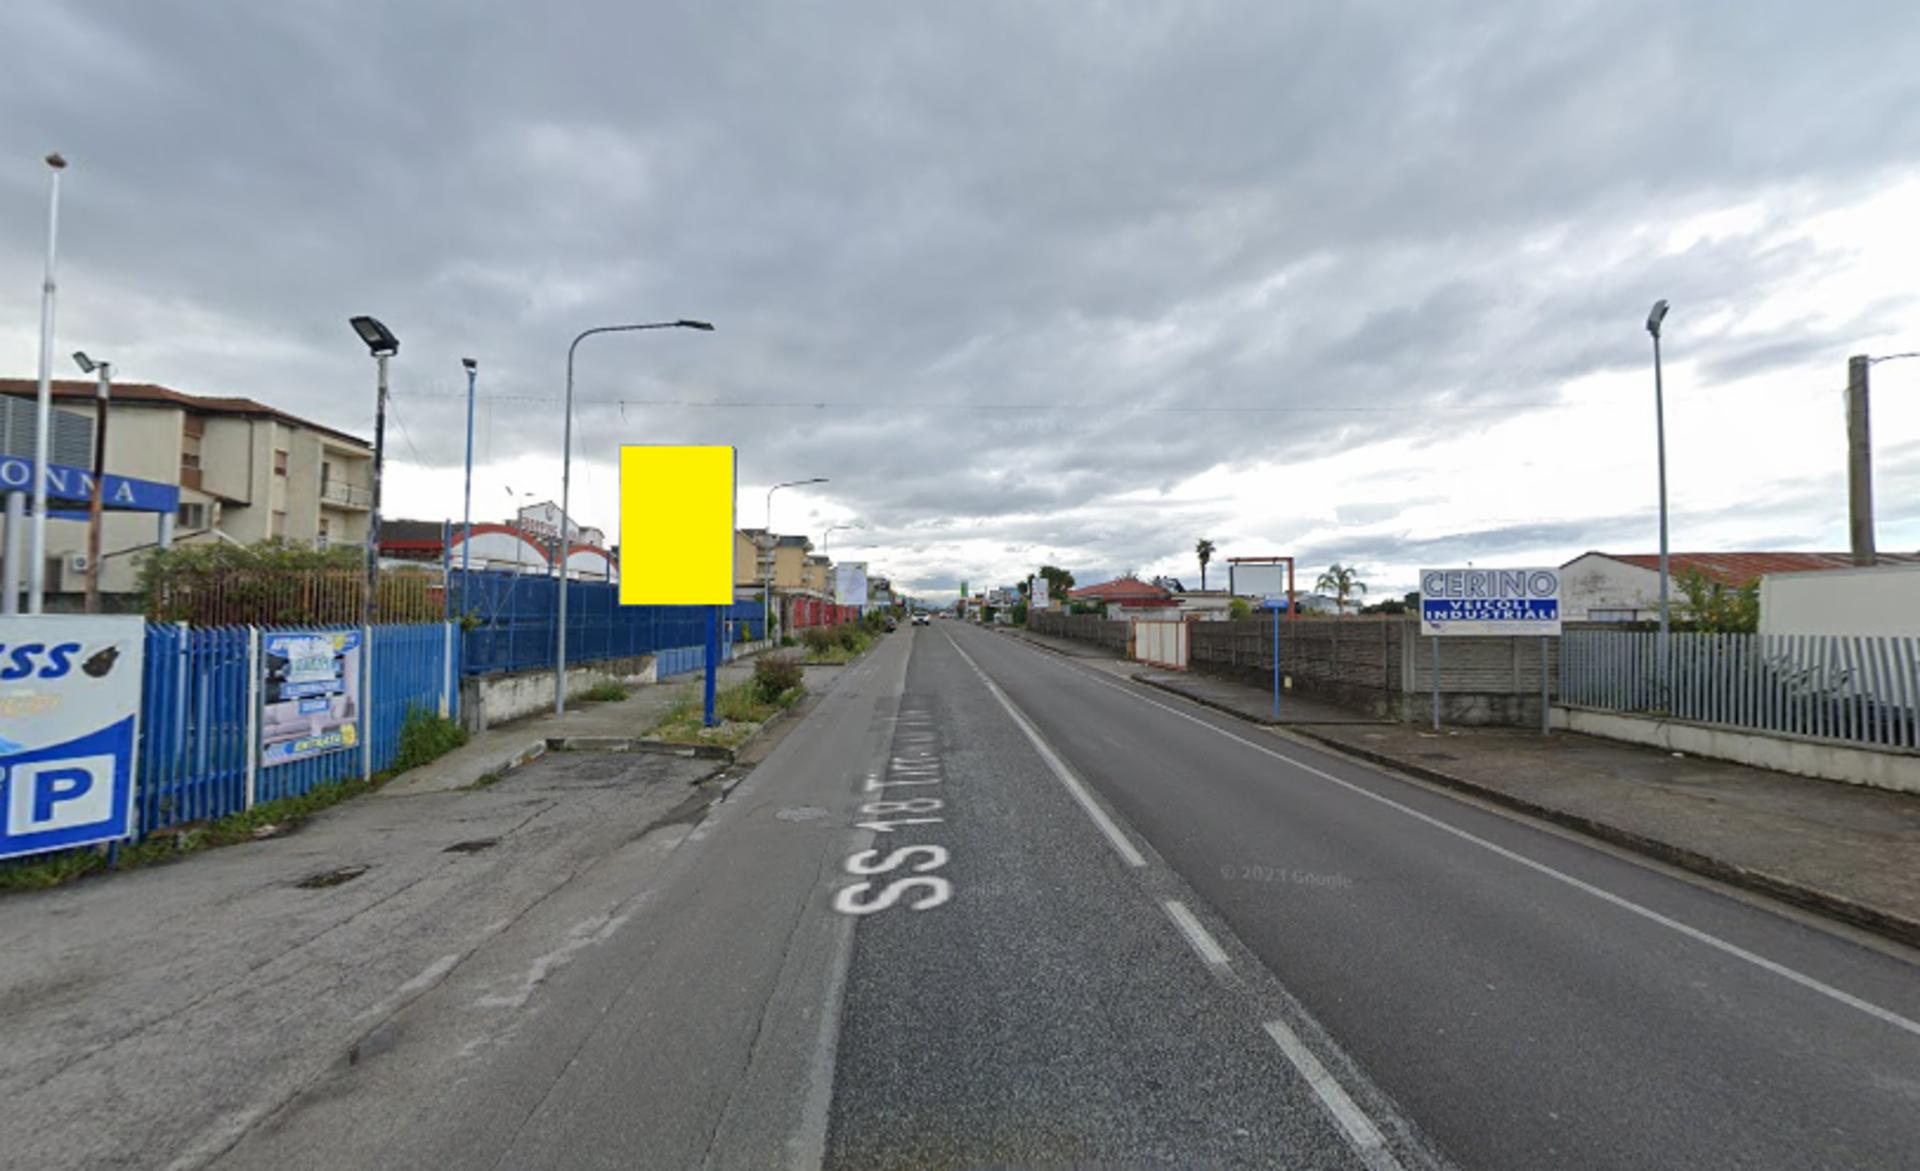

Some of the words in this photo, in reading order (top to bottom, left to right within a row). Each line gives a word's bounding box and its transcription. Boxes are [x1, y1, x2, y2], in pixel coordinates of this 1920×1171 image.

[1423, 570, 1558, 598] CERINO
[1425, 610, 1556, 620] INDUSTRIALI
[31, 767, 94, 823] P
